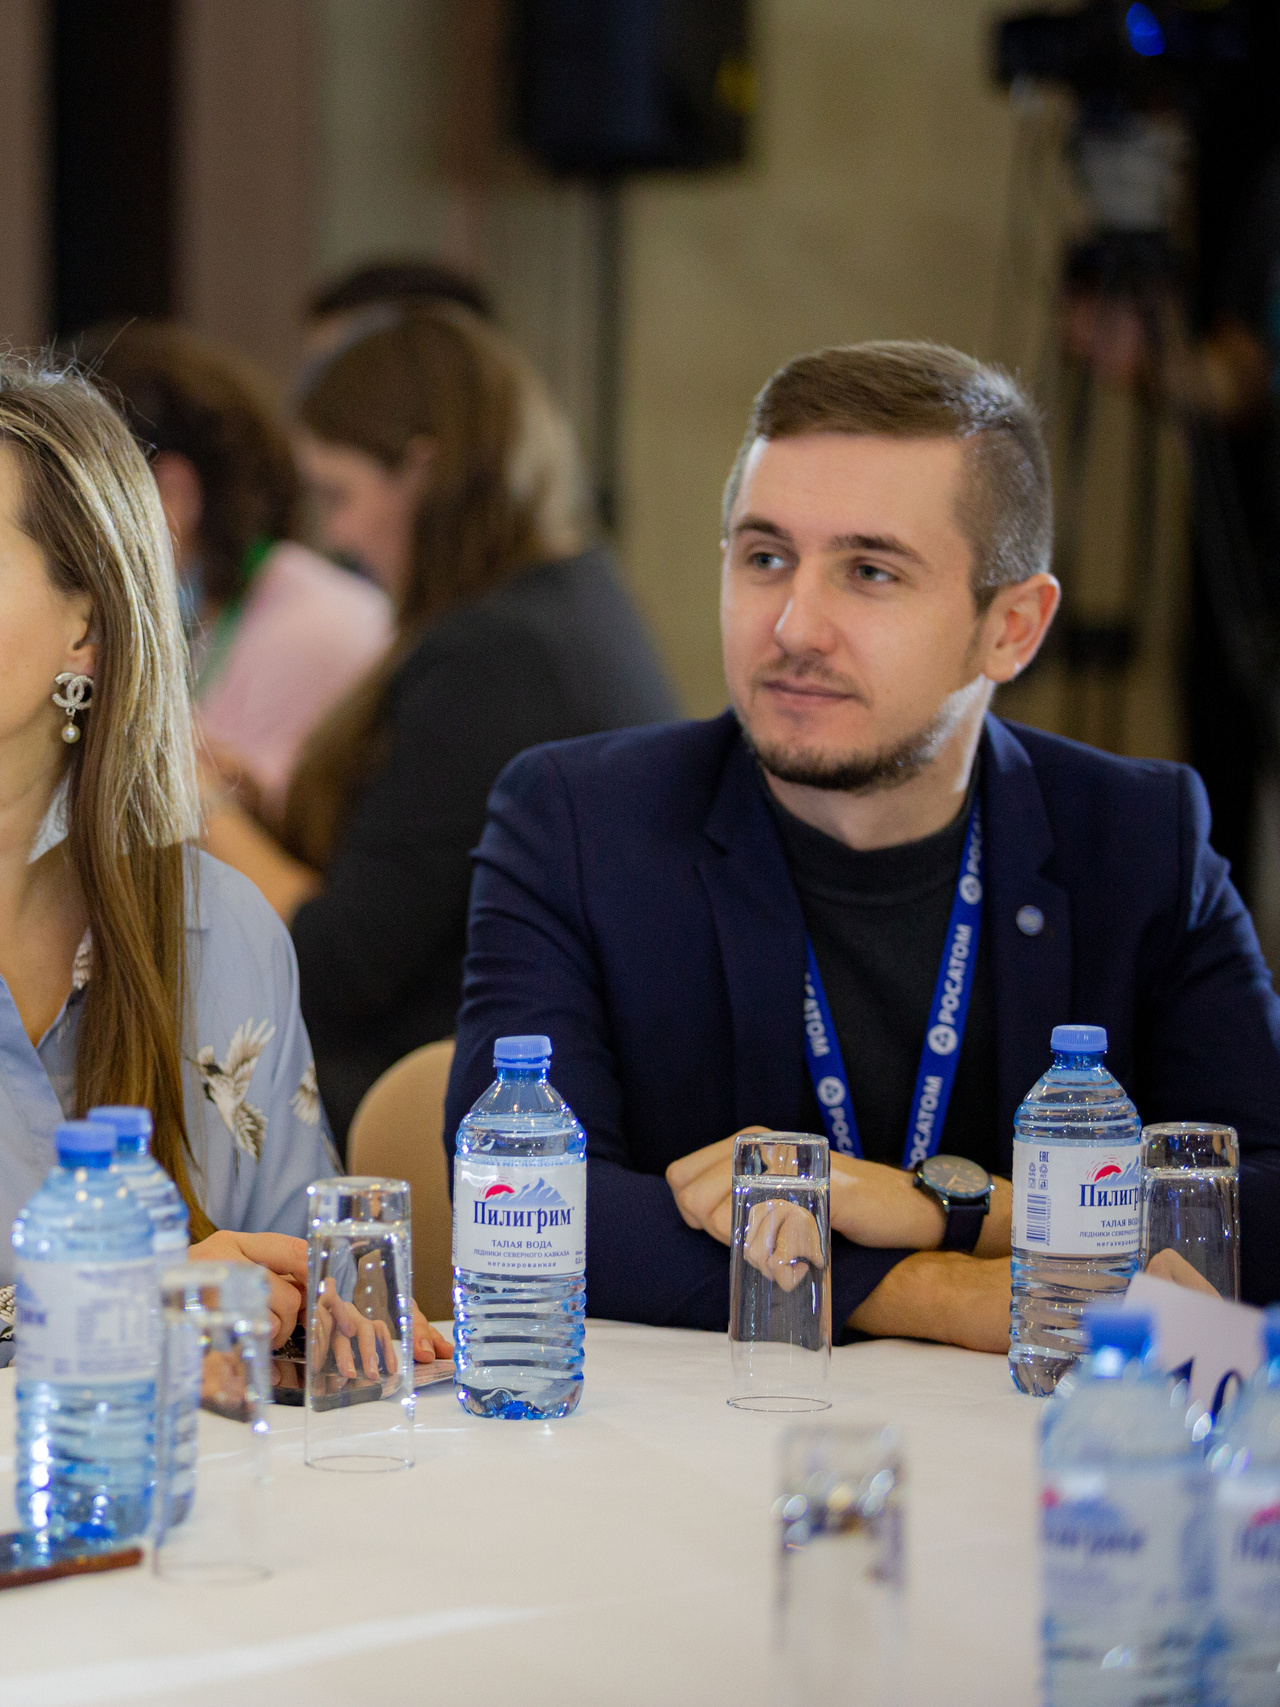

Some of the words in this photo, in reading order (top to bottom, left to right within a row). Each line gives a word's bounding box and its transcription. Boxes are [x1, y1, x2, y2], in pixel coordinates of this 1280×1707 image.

[938, 924, 972, 1025] РОСАТОМ
[1079, 1184, 1140, 1211] Пилигр
[473, 1200, 571, 1234] Пилигрим
[1101, 1219, 1126, 1228] ТАЛАЯ
[491, 1240, 522, 1249] ТАЛАЯ
[526, 1240, 553, 1250] ВОДА
[473, 1248, 501, 1257] ЛЕДНИКИ
[544, 1250, 570, 1258] КАВКАЗА
[487, 1261, 557, 1269] негазированная
